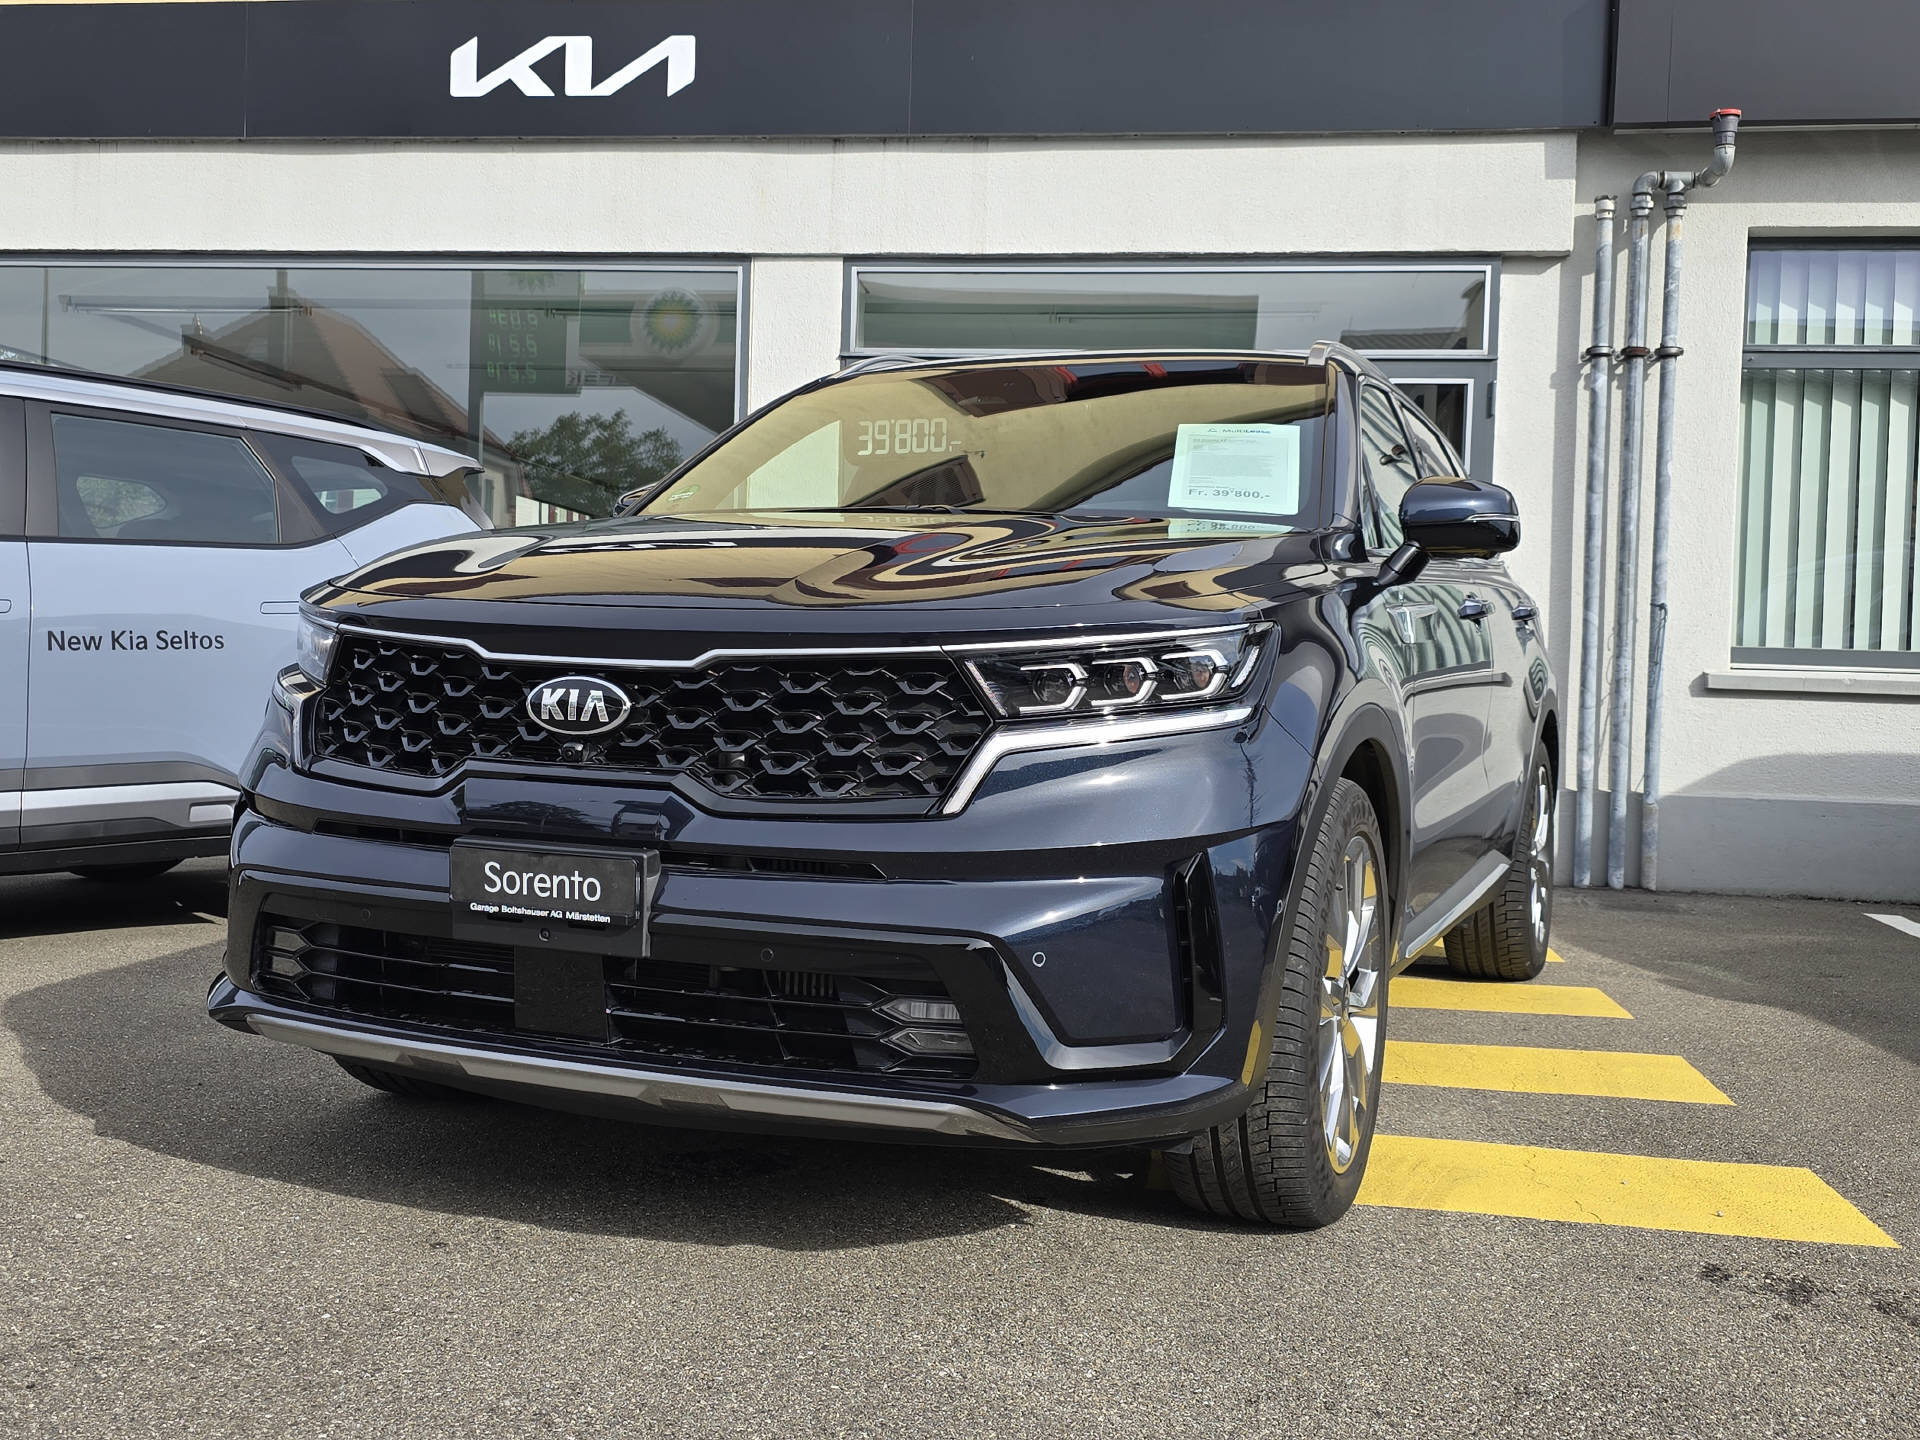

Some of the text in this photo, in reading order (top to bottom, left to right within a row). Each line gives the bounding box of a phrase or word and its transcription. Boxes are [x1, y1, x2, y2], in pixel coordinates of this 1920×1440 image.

[450, 35, 696, 97] KIA
[1188, 488, 1208, 497] Fr.
[47, 629, 225, 651] New Kia Seltos
[541, 688, 609, 722] KIA
[484, 861, 601, 902] Sorento
[469, 902, 499, 913] Garage
[550, 910, 563, 919] AG
